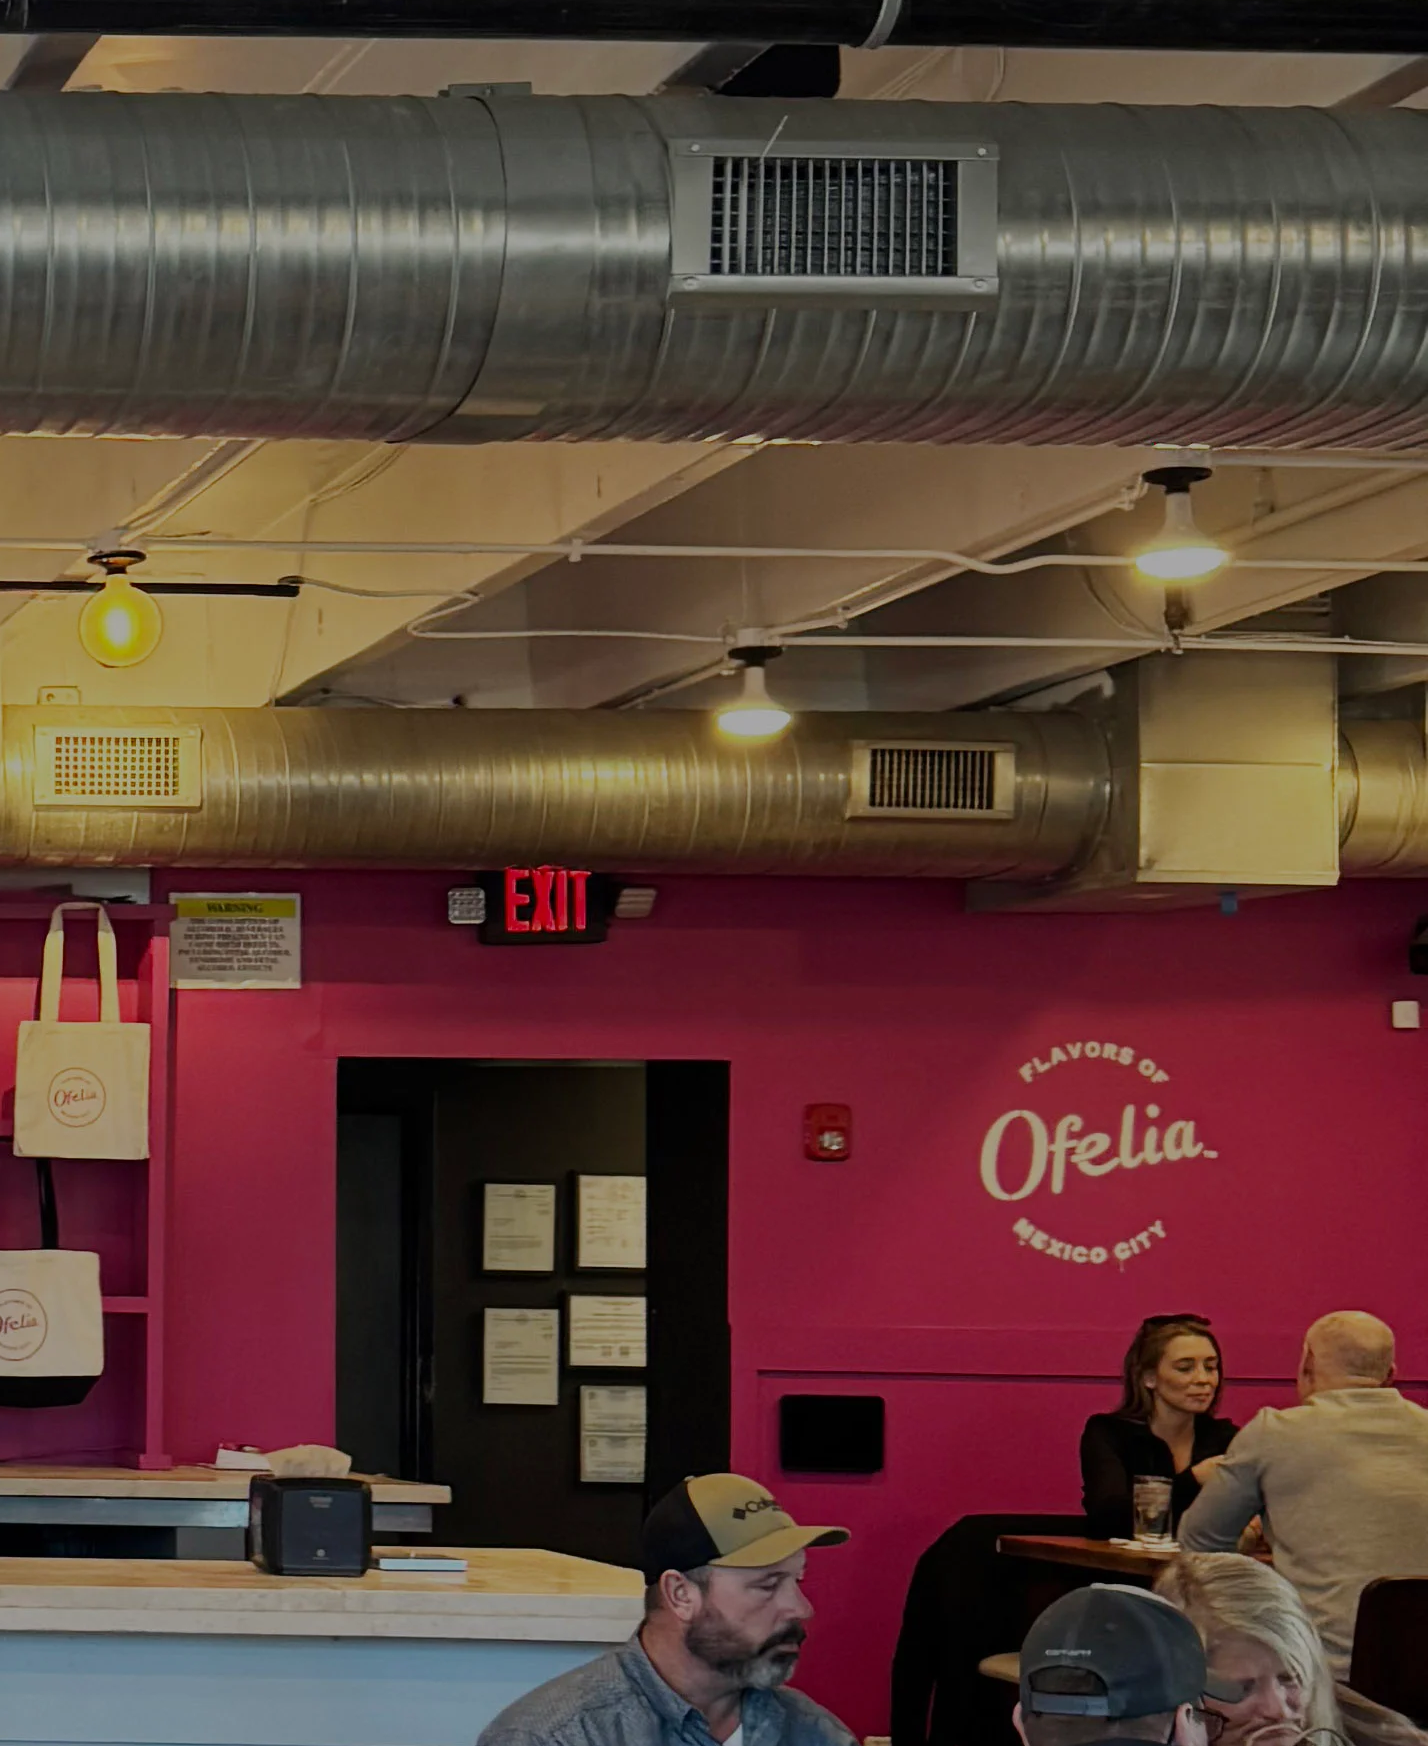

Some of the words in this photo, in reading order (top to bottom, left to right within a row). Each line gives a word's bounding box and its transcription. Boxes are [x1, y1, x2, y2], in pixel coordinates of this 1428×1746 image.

[504, 866, 592, 933] EXIT
[1018, 1041, 1135, 1084] FLAVORS
[1137, 1058, 1169, 1084] OF
[980, 1104, 1219, 1201] Ofelia
[1012, 1217, 1109, 1264] MEXICO
[1113, 1219, 1166, 1261] CITY
